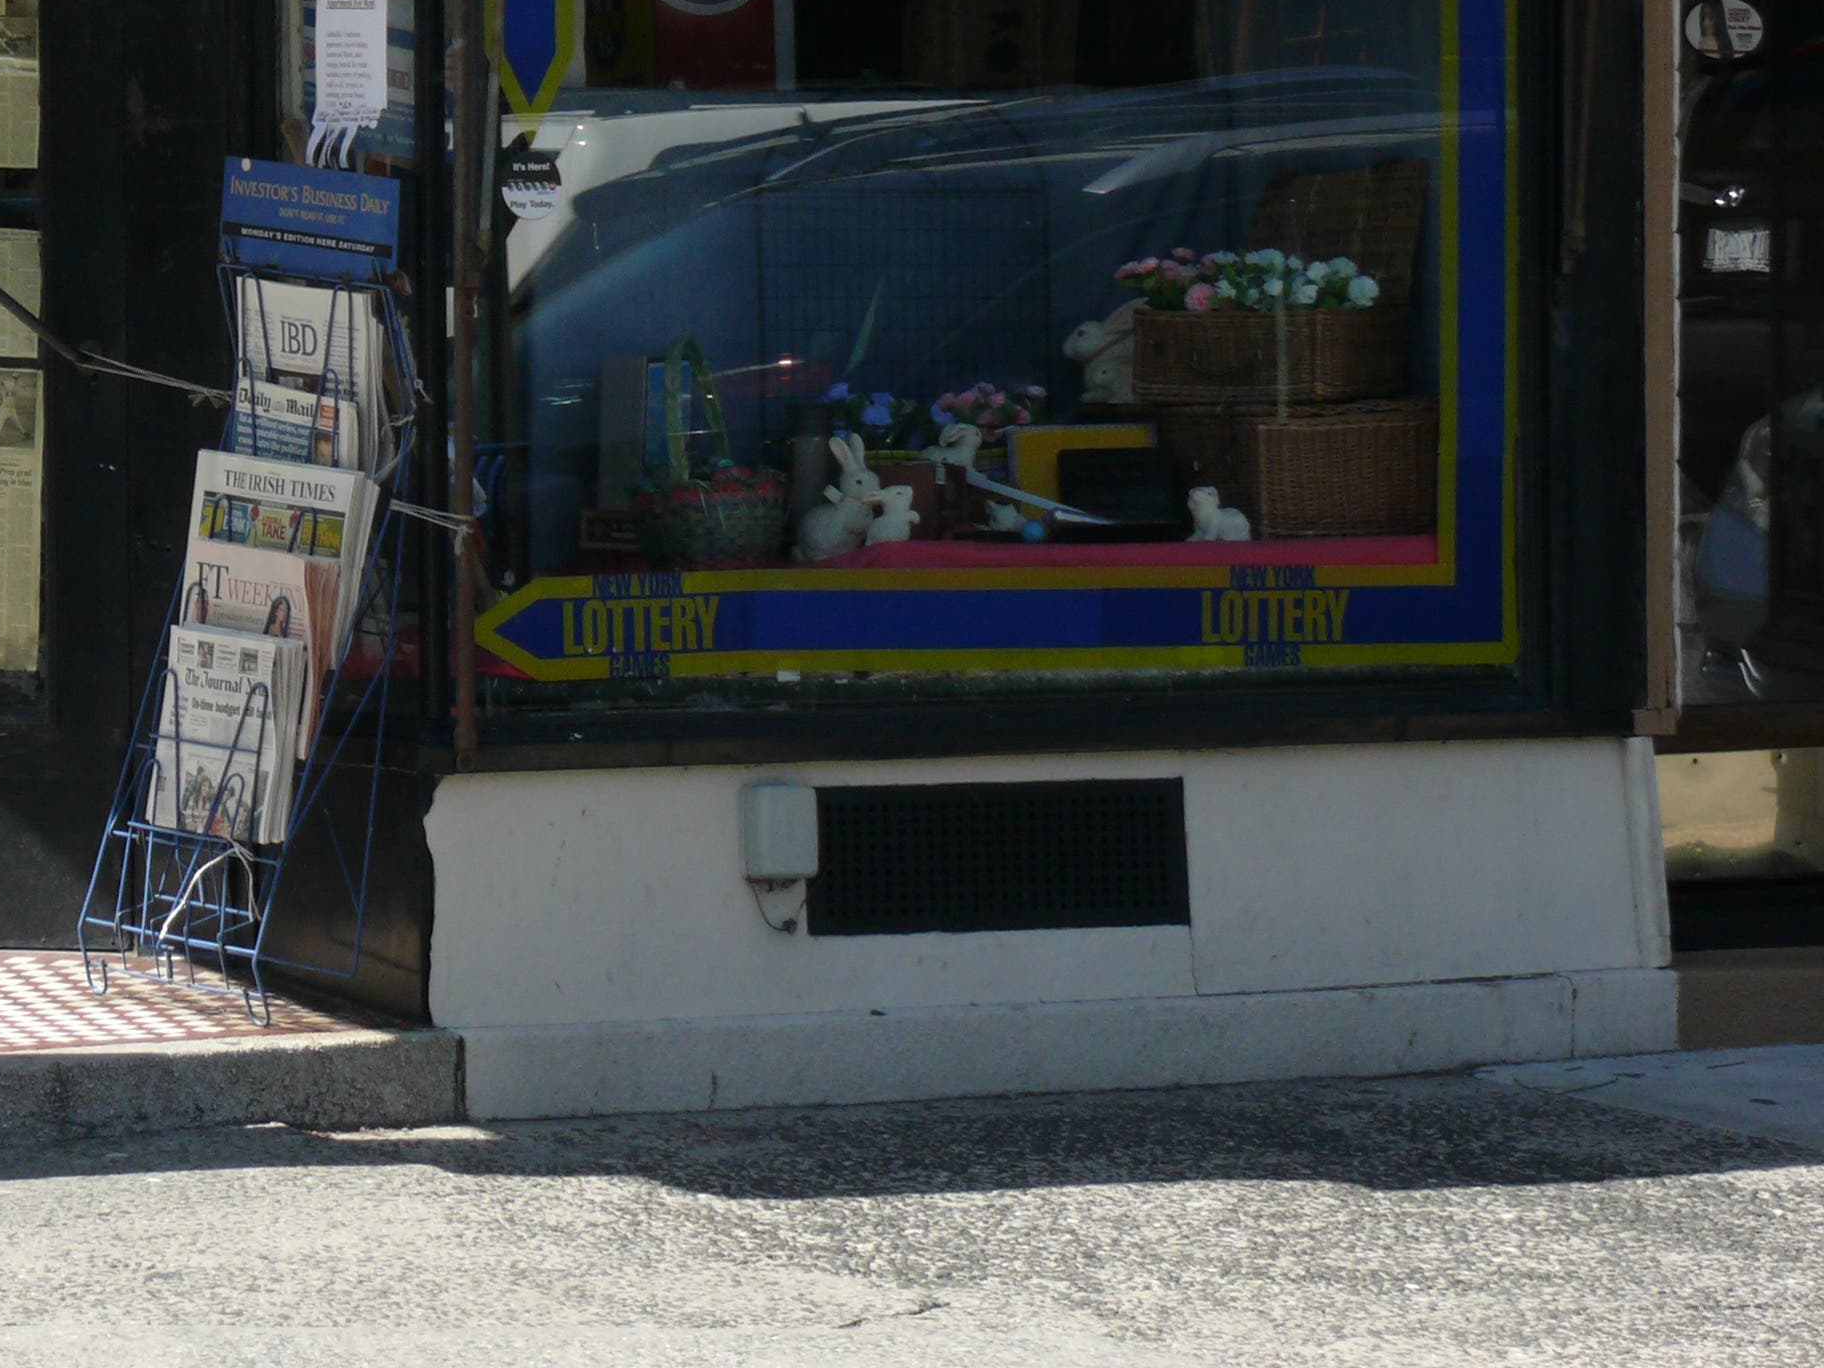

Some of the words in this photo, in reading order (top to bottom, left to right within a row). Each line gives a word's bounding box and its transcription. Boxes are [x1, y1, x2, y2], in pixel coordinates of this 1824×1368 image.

[241, 227, 281, 241] MONDAY'S
[283, 233, 315, 245] EDITION
[316, 238, 337, 248] HERE
[338, 240, 376, 253] SATURDAY
[279, 319, 318, 356] IBD
[286, 398, 315, 418] Mail
[224, 469, 247, 490] THE
[248, 474, 285, 496] IRISH
[289, 479, 336, 503] TIMES
[262, 522, 287, 541] TAKE
[562, 596, 720, 656] LOTTERY
[1201, 589, 1350, 642] LOTTERY
[185, 668, 200, 687] The
[200, 671, 243, 694] Journal
[215, 699, 241, 717] budget
